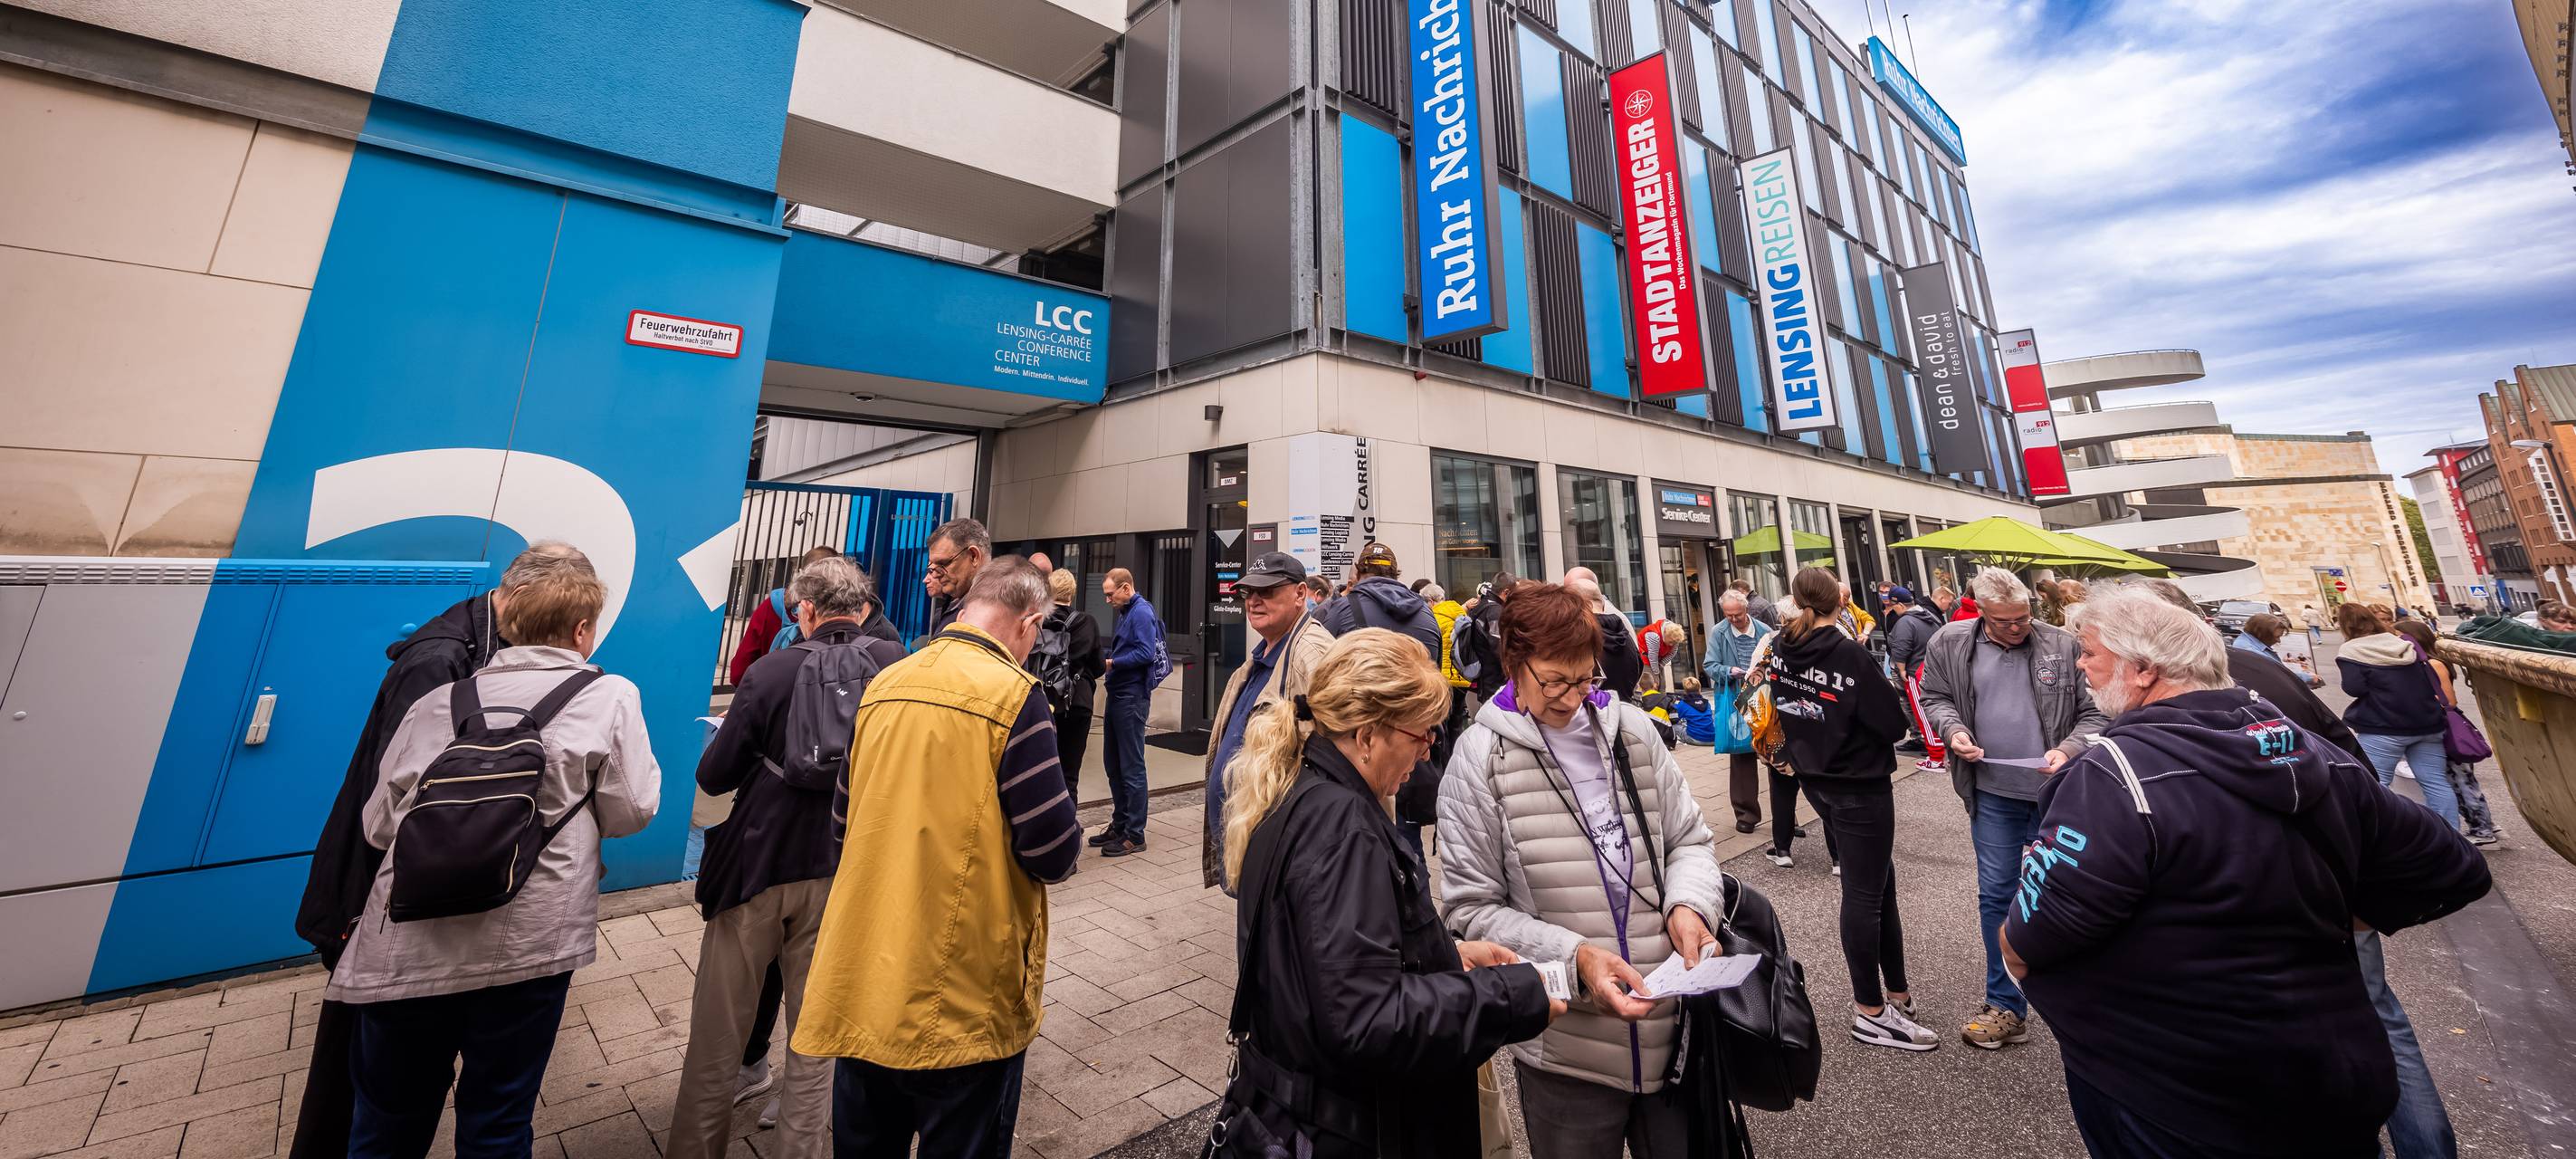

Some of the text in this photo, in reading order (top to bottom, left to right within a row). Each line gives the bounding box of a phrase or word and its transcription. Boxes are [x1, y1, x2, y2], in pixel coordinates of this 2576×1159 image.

[1880, 49, 1961, 149] Ruhr Nachrichten
[1665, 171, 1676, 206] Dortmund
[1669, 208, 1677, 219] für
[1627, 117, 1683, 364] STADTANZEIGER
[1672, 219, 1685, 278] Wochenmagazin
[1431, 199, 1477, 319] Ruhr
[640, 317, 733, 341] Feuerwehrzufahrt
[1035, 301, 1092, 335] LCC
[654, 332, 683, 342] Haltverbot
[997, 321, 1092, 350] LENSING-CARRÉE
[1017, 340, 1092, 362] CONFERENCE
[1941, 311, 1962, 376] fresh to eat
[994, 365, 1090, 386] Modern. Mittendrin. Individuell.
[995, 350, 1040, 367] CENTER
[1917, 313, 1960, 430] dean & david
[1355, 436, 1369, 511] CARRÉE
[1779, 676, 1817, 694] SINCE 1950
